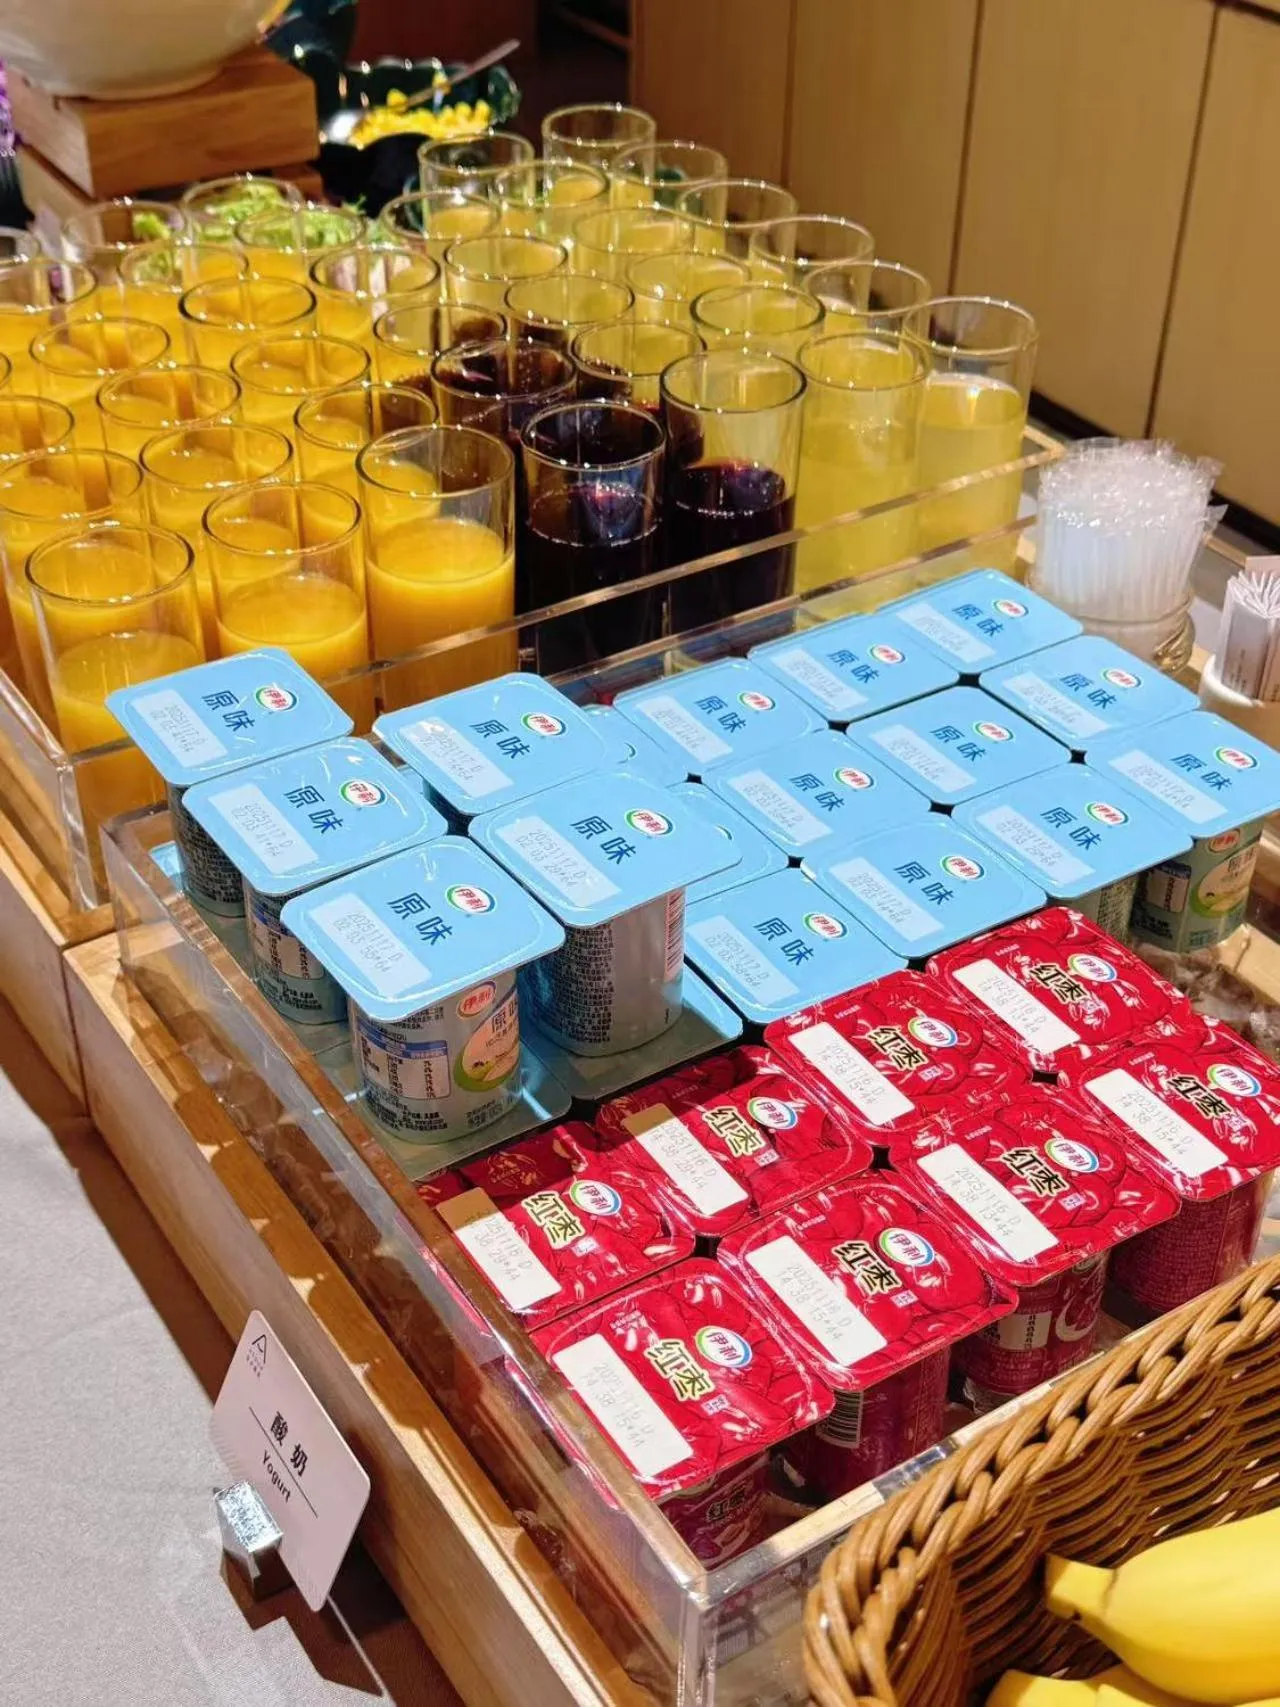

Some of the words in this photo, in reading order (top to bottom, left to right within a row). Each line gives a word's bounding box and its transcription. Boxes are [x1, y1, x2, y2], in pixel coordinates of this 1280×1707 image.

[952, 602, 1004, 637] 原味
[827, 650, 879, 684] 原味
[202, 690, 261, 731] 原味
[264, 689, 287, 709] 伊利
[1060, 674, 1116, 709] 原味
[533, 715, 558, 733] 伊利
[694, 695, 746, 733] 原味
[469, 719, 530, 759] 原味
[929, 724, 986, 762] 原味
[1222, 748, 1250, 768] 伊利
[843, 770, 867, 788] 伊利
[1170, 751, 1232, 791] 原味
[284, 785, 348, 834] 原味
[350, 783, 377, 803] 伊利
[789, 771, 844, 812] 原味
[634, 812, 665, 833] 伊利
[1040, 807, 1102, 850] 原味
[1092, 803, 1122, 824] 伊利
[570, 815, 636, 864] 原味
[893, 861, 954, 905] 原味
[949, 858, 979, 880] 伊利
[456, 888, 487, 911] 伊利
[387, 892, 454, 946] 原味
[813, 916, 840, 936] 伊利
[753, 917, 814, 966] 原味
[1029, 963, 1091, 1002] 红枣
[1076, 957, 1112, 979] 伊利
[867, 1026, 928, 1069] 红枣
[917, 1022, 949, 1043] 伊利
[1167, 1075, 1232, 1119] 红枣
[1215, 1068, 1252, 1092] 伊利
[702, 1106, 767, 1156] 红枣
[757, 1101, 790, 1126] 伊利
[1003, 1149, 1067, 1195] 红枣
[1052, 1143, 1090, 1167] 伊利
[578, 1184, 614, 1210] 伊利
[523, 1193, 582, 1246] 红枣
[834, 1242, 902, 1291] 红枣
[890, 1233, 925, 1262] 伊利
[705, 1332, 744, 1361] 伊利
[645, 1341, 714, 1400] 红枣
[270, 1411, 308, 1477] 酸奶
[262, 1450, 292, 1502] Yogurt
